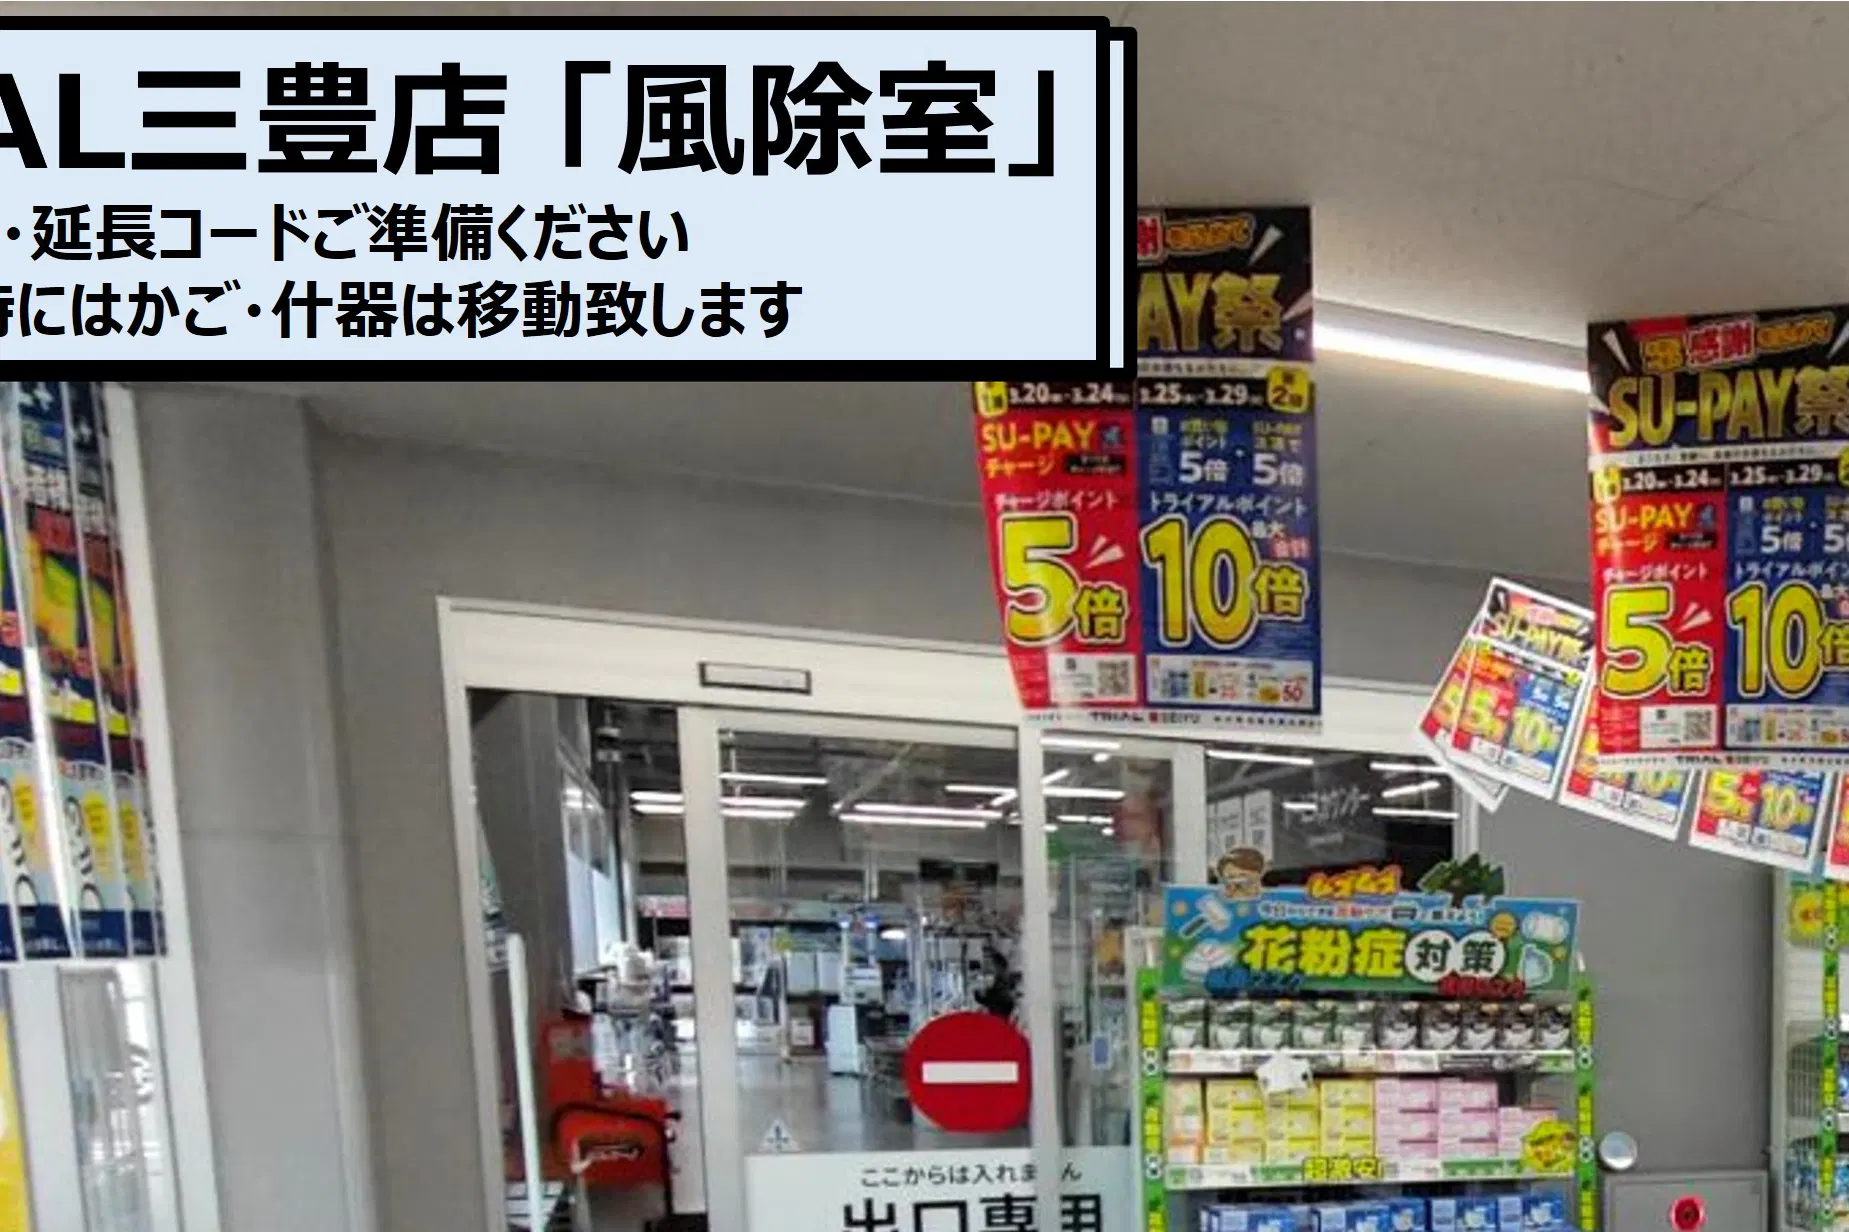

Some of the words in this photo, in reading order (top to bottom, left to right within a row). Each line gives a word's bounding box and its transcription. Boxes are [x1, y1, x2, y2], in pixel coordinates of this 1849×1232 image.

[981, 420, 1098, 454] SU-PAY
[1178, 451, 1230, 484] 5倍
[1252, 453, 1306, 487] 5倍
[1150, 490, 1308, 515] トライアルポイント
[1595, 502, 1693, 533] SU-PAY
[999, 511, 1129, 648] 5倍
[1141, 513, 1310, 649] 10倍
[1601, 581, 1714, 699] 5倍
[1243, 924, 1498, 978] 花粉症対策
[860, 1162, 1083, 1188] ここからは入れまん
